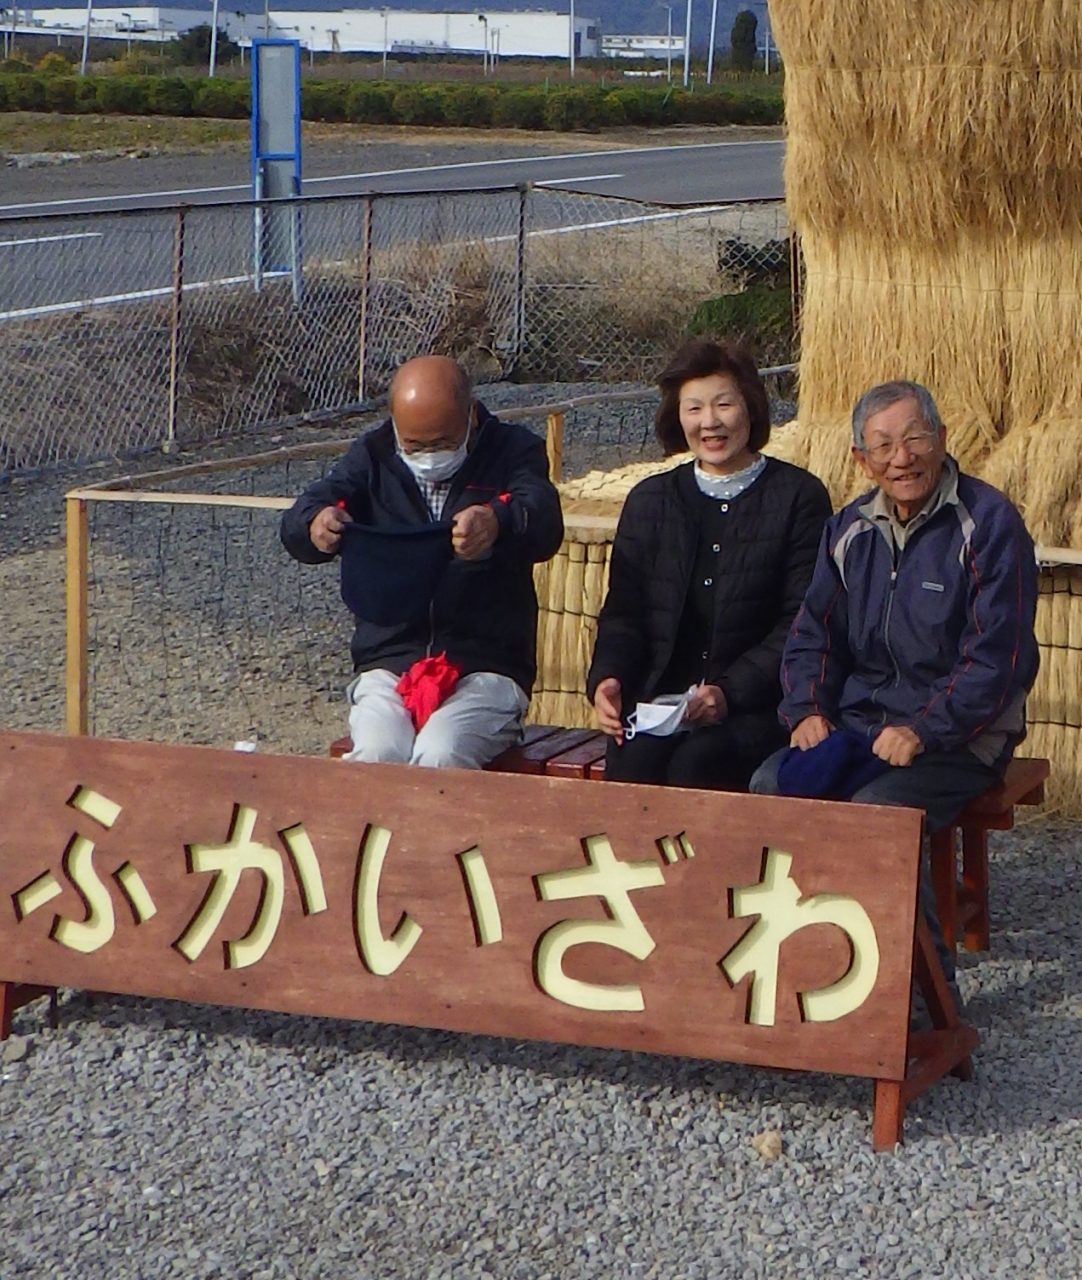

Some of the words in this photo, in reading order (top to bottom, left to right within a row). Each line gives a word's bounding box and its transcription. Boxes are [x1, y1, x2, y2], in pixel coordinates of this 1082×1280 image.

[13, 784, 880, 1027] ふかいざわ
